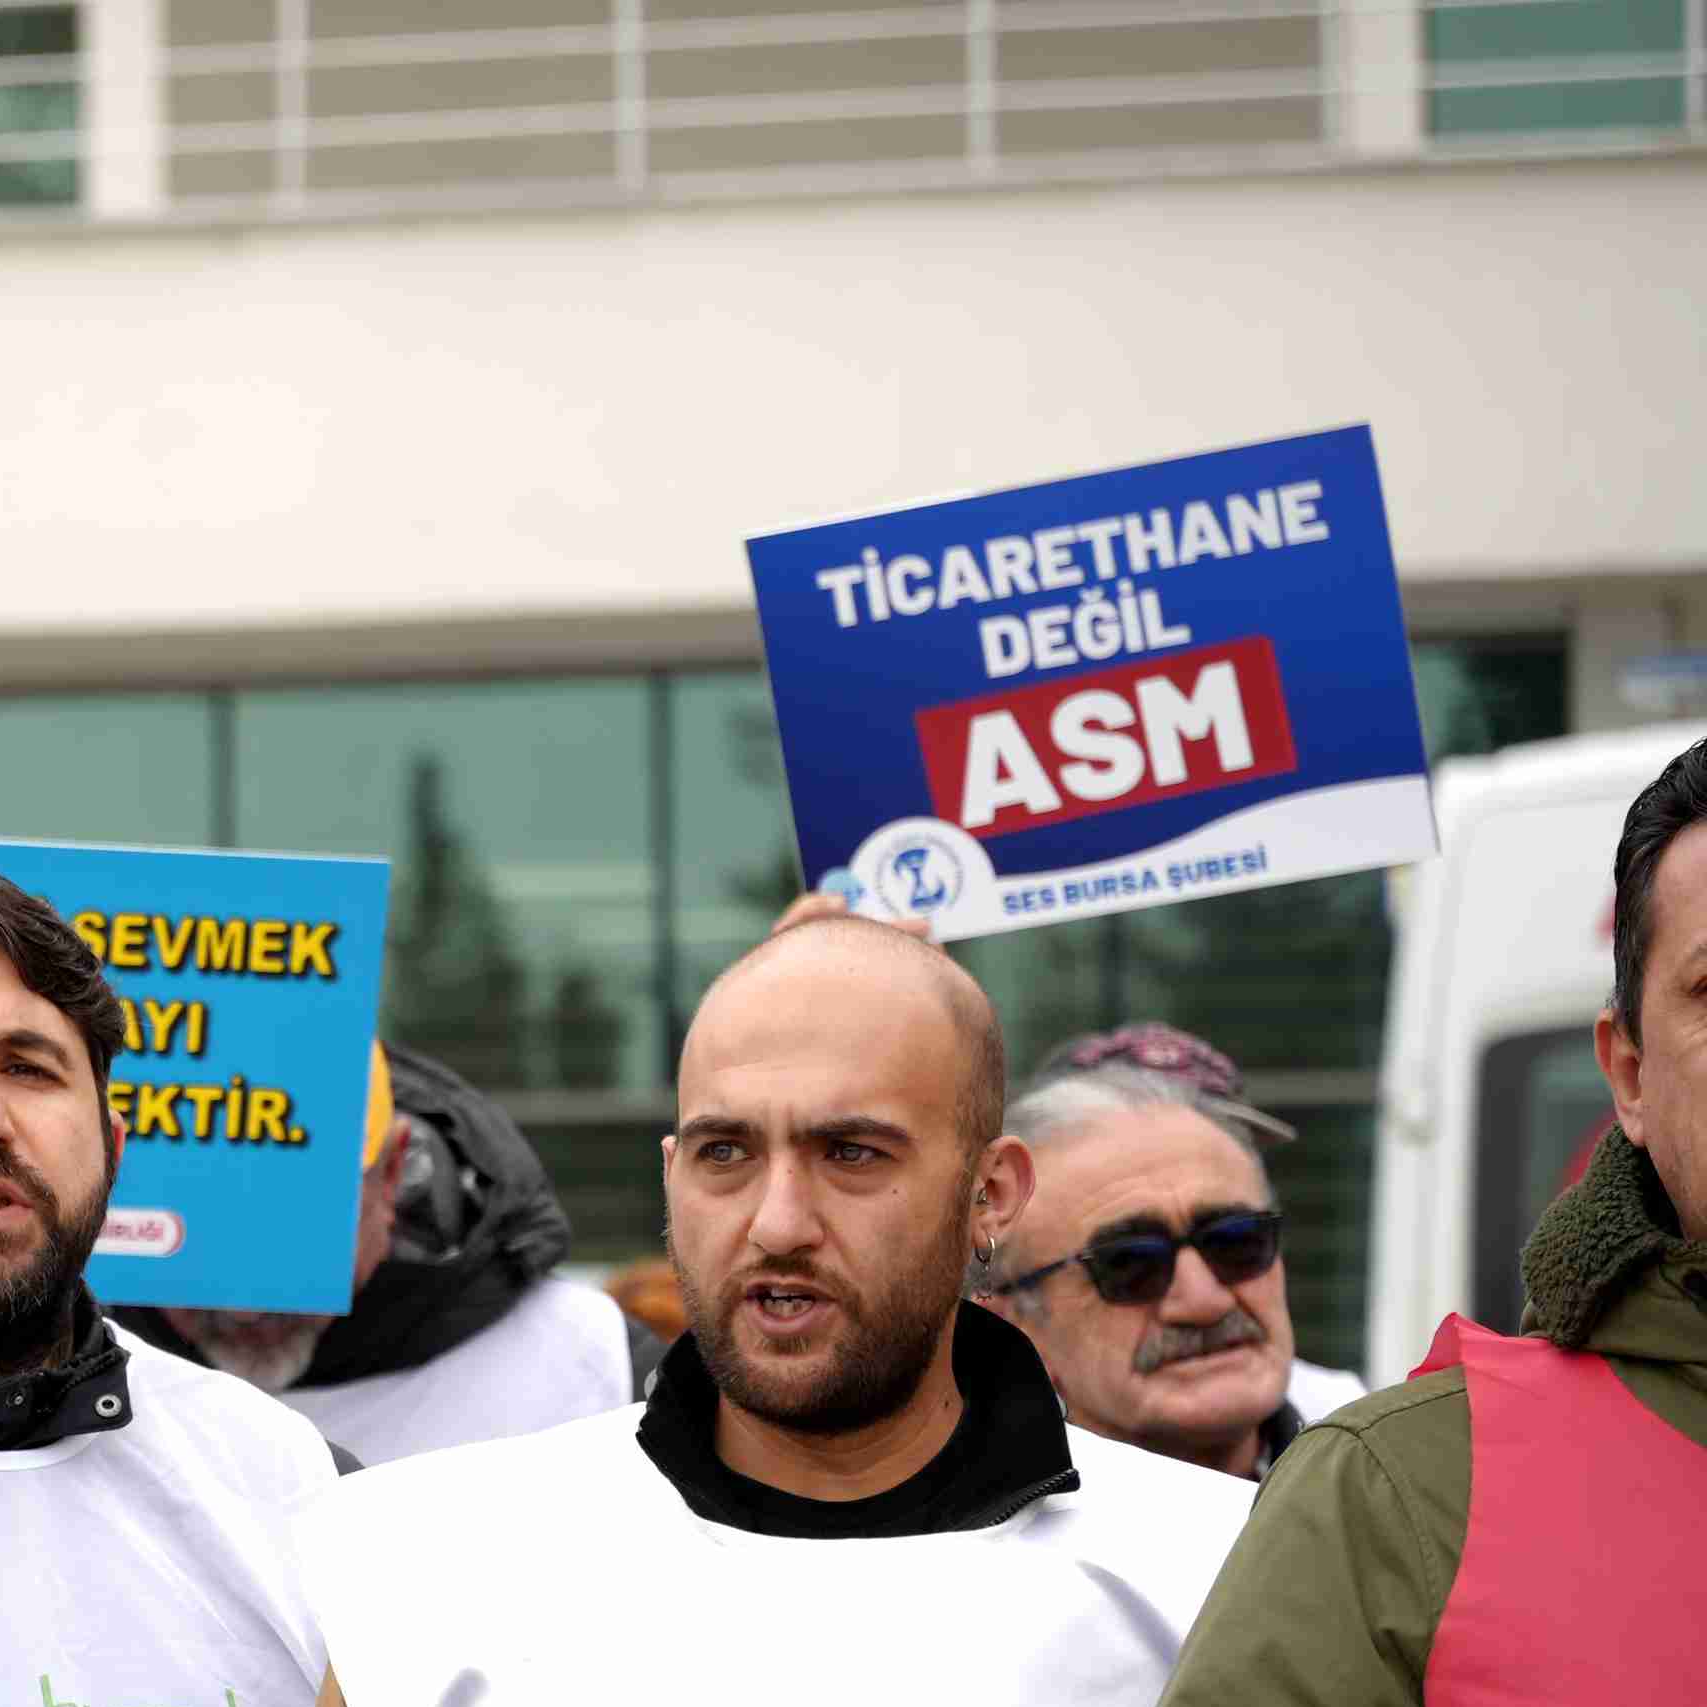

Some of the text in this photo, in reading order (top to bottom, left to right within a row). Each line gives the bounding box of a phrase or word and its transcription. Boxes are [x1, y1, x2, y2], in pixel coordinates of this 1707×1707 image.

[817, 480, 1329, 628] TİCARETHANE
[979, 588, 1190, 678] DEĞİL
[961, 660, 1254, 828] ASM
[1003, 842, 1268, 914] SES BURSA ŞUBESİ
[73, 912, 336, 976] SEVMEK
[107, 1074, 305, 1142] EKTİR.
